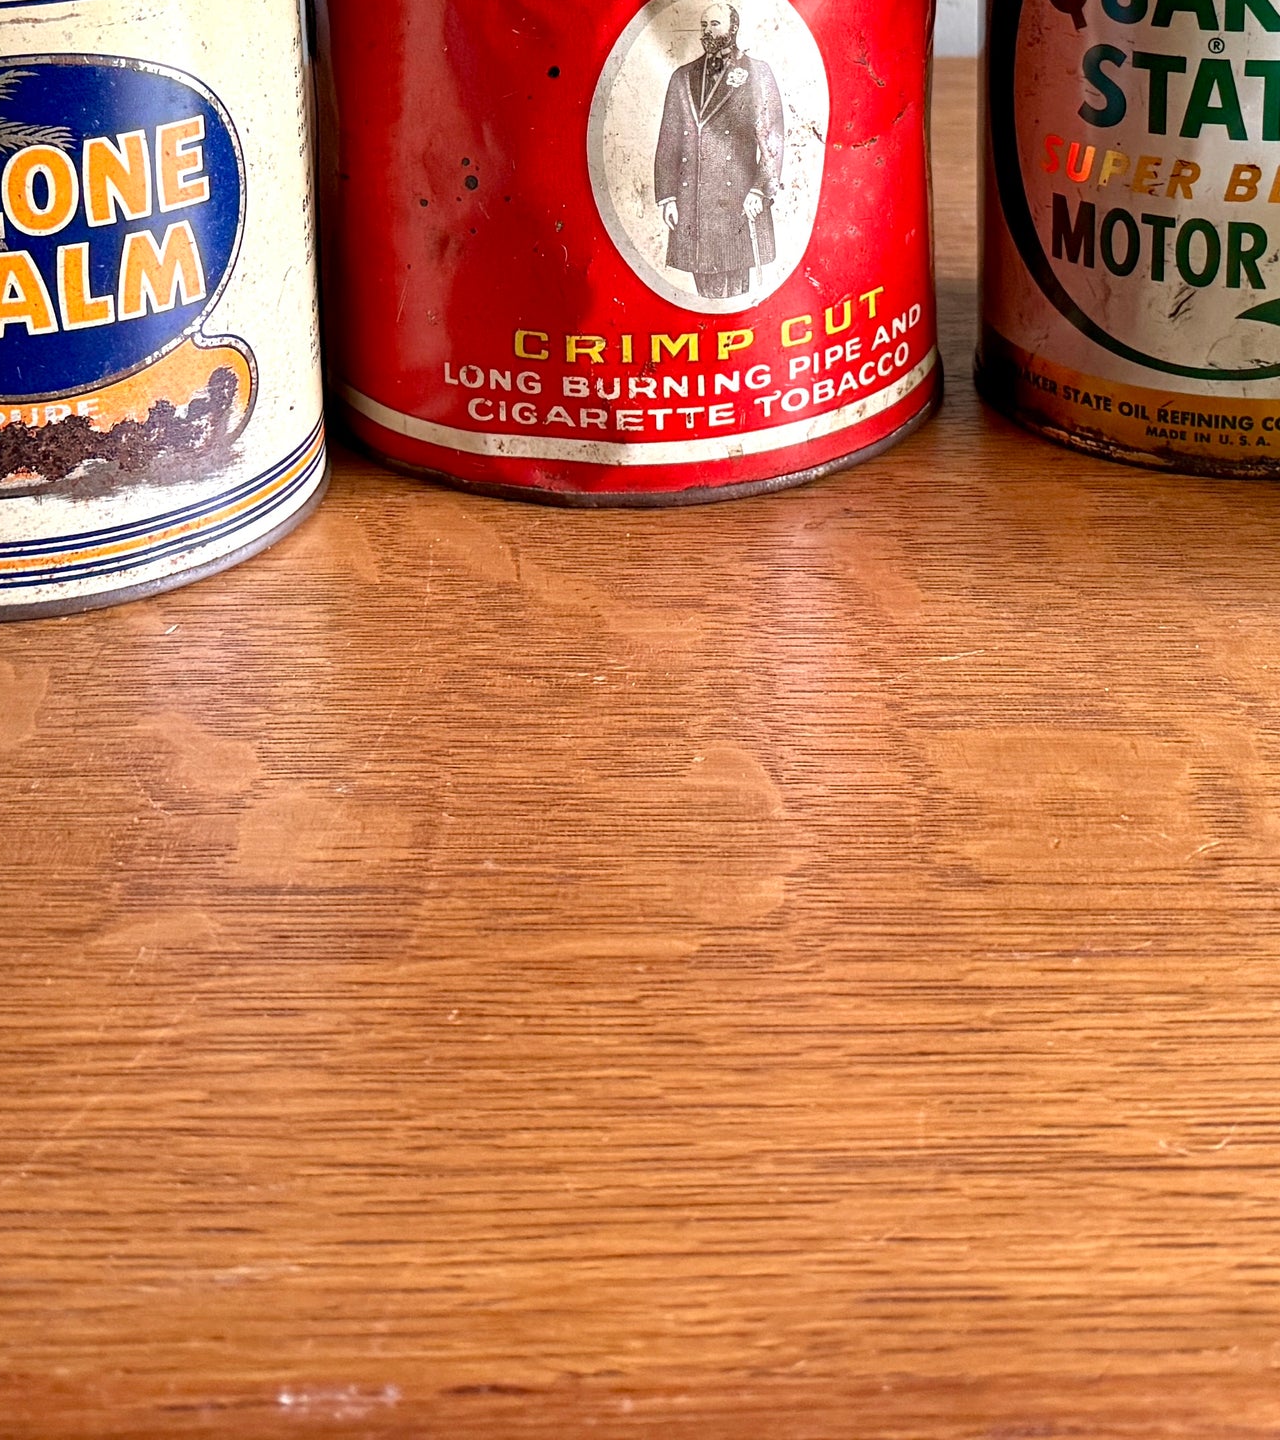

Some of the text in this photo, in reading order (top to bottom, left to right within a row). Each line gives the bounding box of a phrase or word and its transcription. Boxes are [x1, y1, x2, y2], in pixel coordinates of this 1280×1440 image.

[1041, 134, 1202, 201] SUPER
[1052, 192, 1268, 291] MOTOR
[444, 302, 922, 400] LONG BURNING PIPE AND
[515, 285, 885, 364] CRIMP CUT
[467, 341, 910, 433] CIGARETTE TOBACCO
[1063, 385, 1113, 413] STATE
[1118, 402, 1150, 421] OIL
[1157, 407, 1255, 432] REFINING
[1145, 425, 1187, 441] MADE
[1194, 430, 1211, 443] IN
